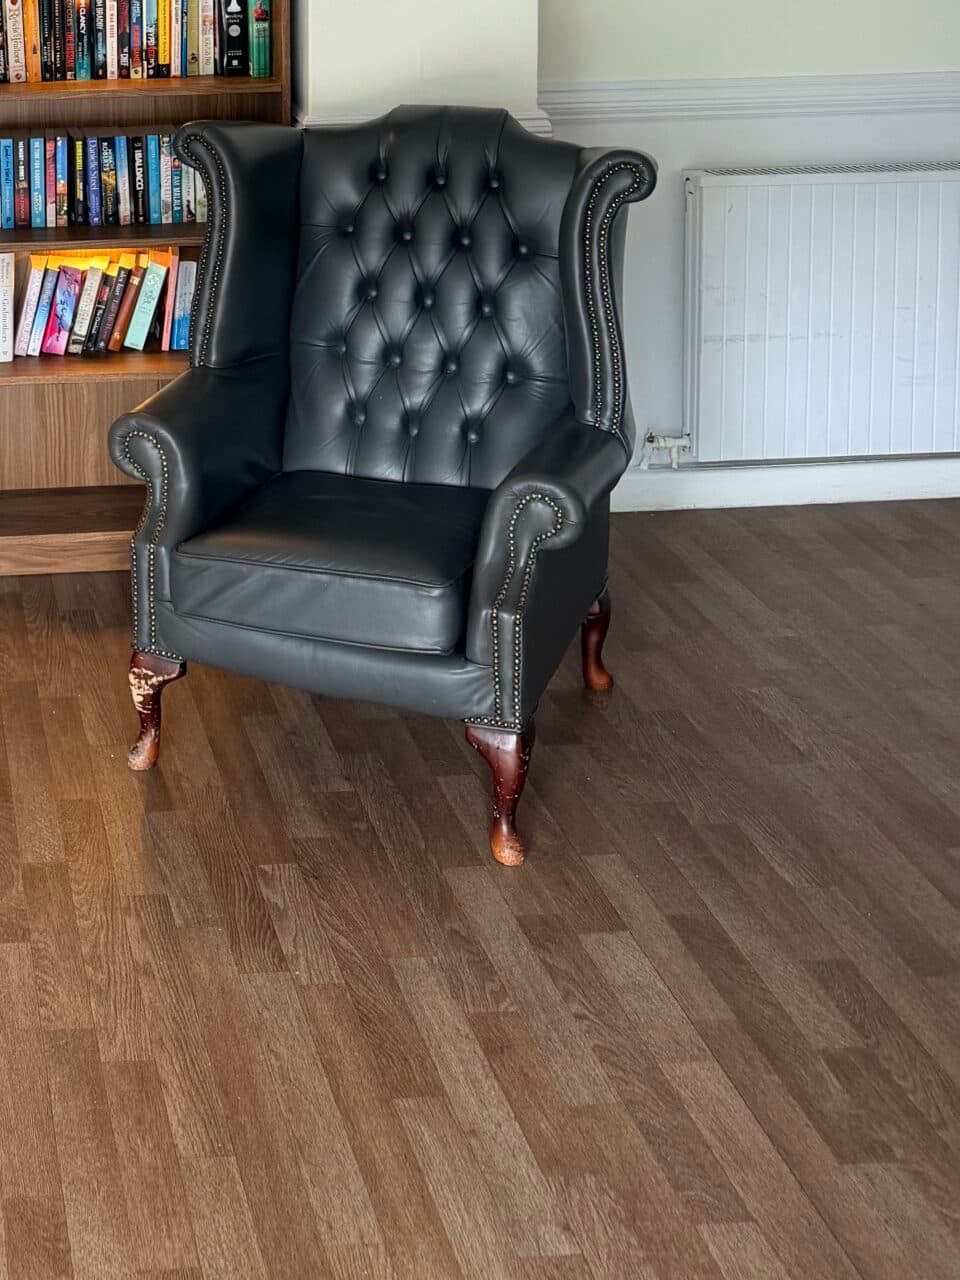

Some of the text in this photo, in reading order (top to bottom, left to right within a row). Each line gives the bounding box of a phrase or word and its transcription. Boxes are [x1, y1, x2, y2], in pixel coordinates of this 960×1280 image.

[120, 53, 129, 66] CHEF
[89, 140, 99, 190] Danielle Steel
[134, 153, 142, 190] BALDACCI
[173, 176, 182, 211] AM MALALA
[118, 270, 127, 281] alex
